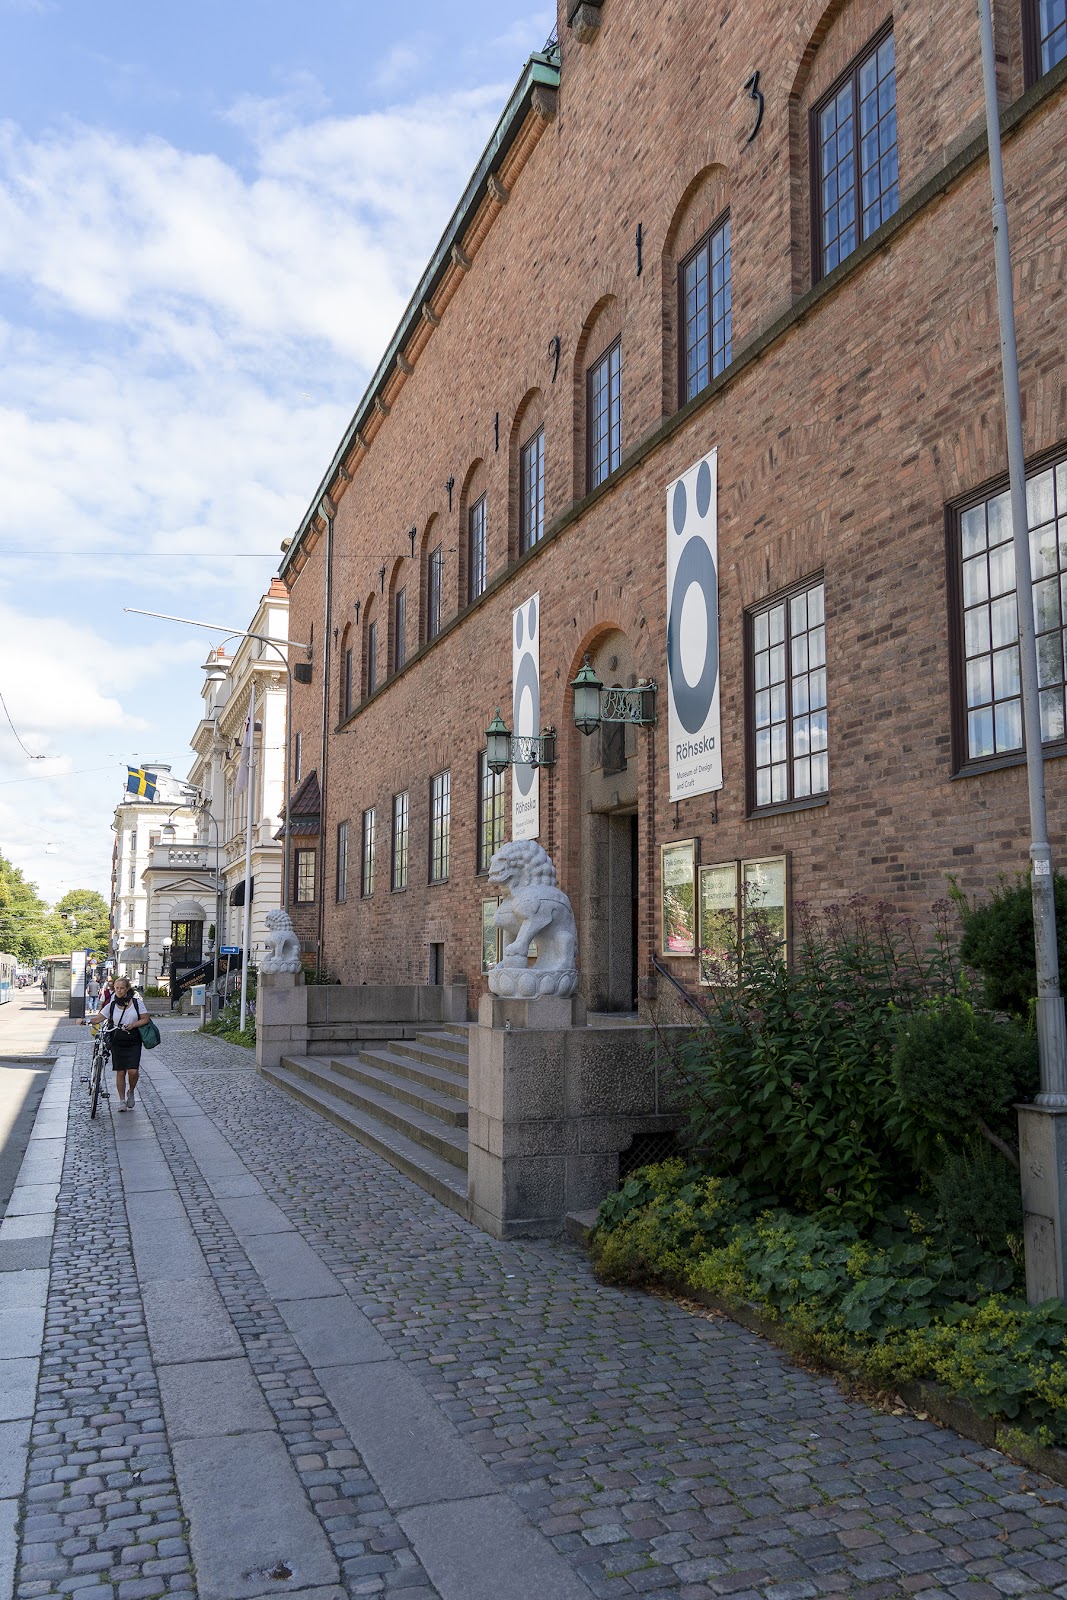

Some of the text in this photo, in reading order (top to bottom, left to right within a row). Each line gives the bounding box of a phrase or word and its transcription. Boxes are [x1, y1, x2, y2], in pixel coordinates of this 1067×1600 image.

[675, 734, 716, 762] Röhsska
[676, 769, 693, 780] Museum
[698, 763, 713, 773] Design
[676, 778, 695, 791] and Craft
